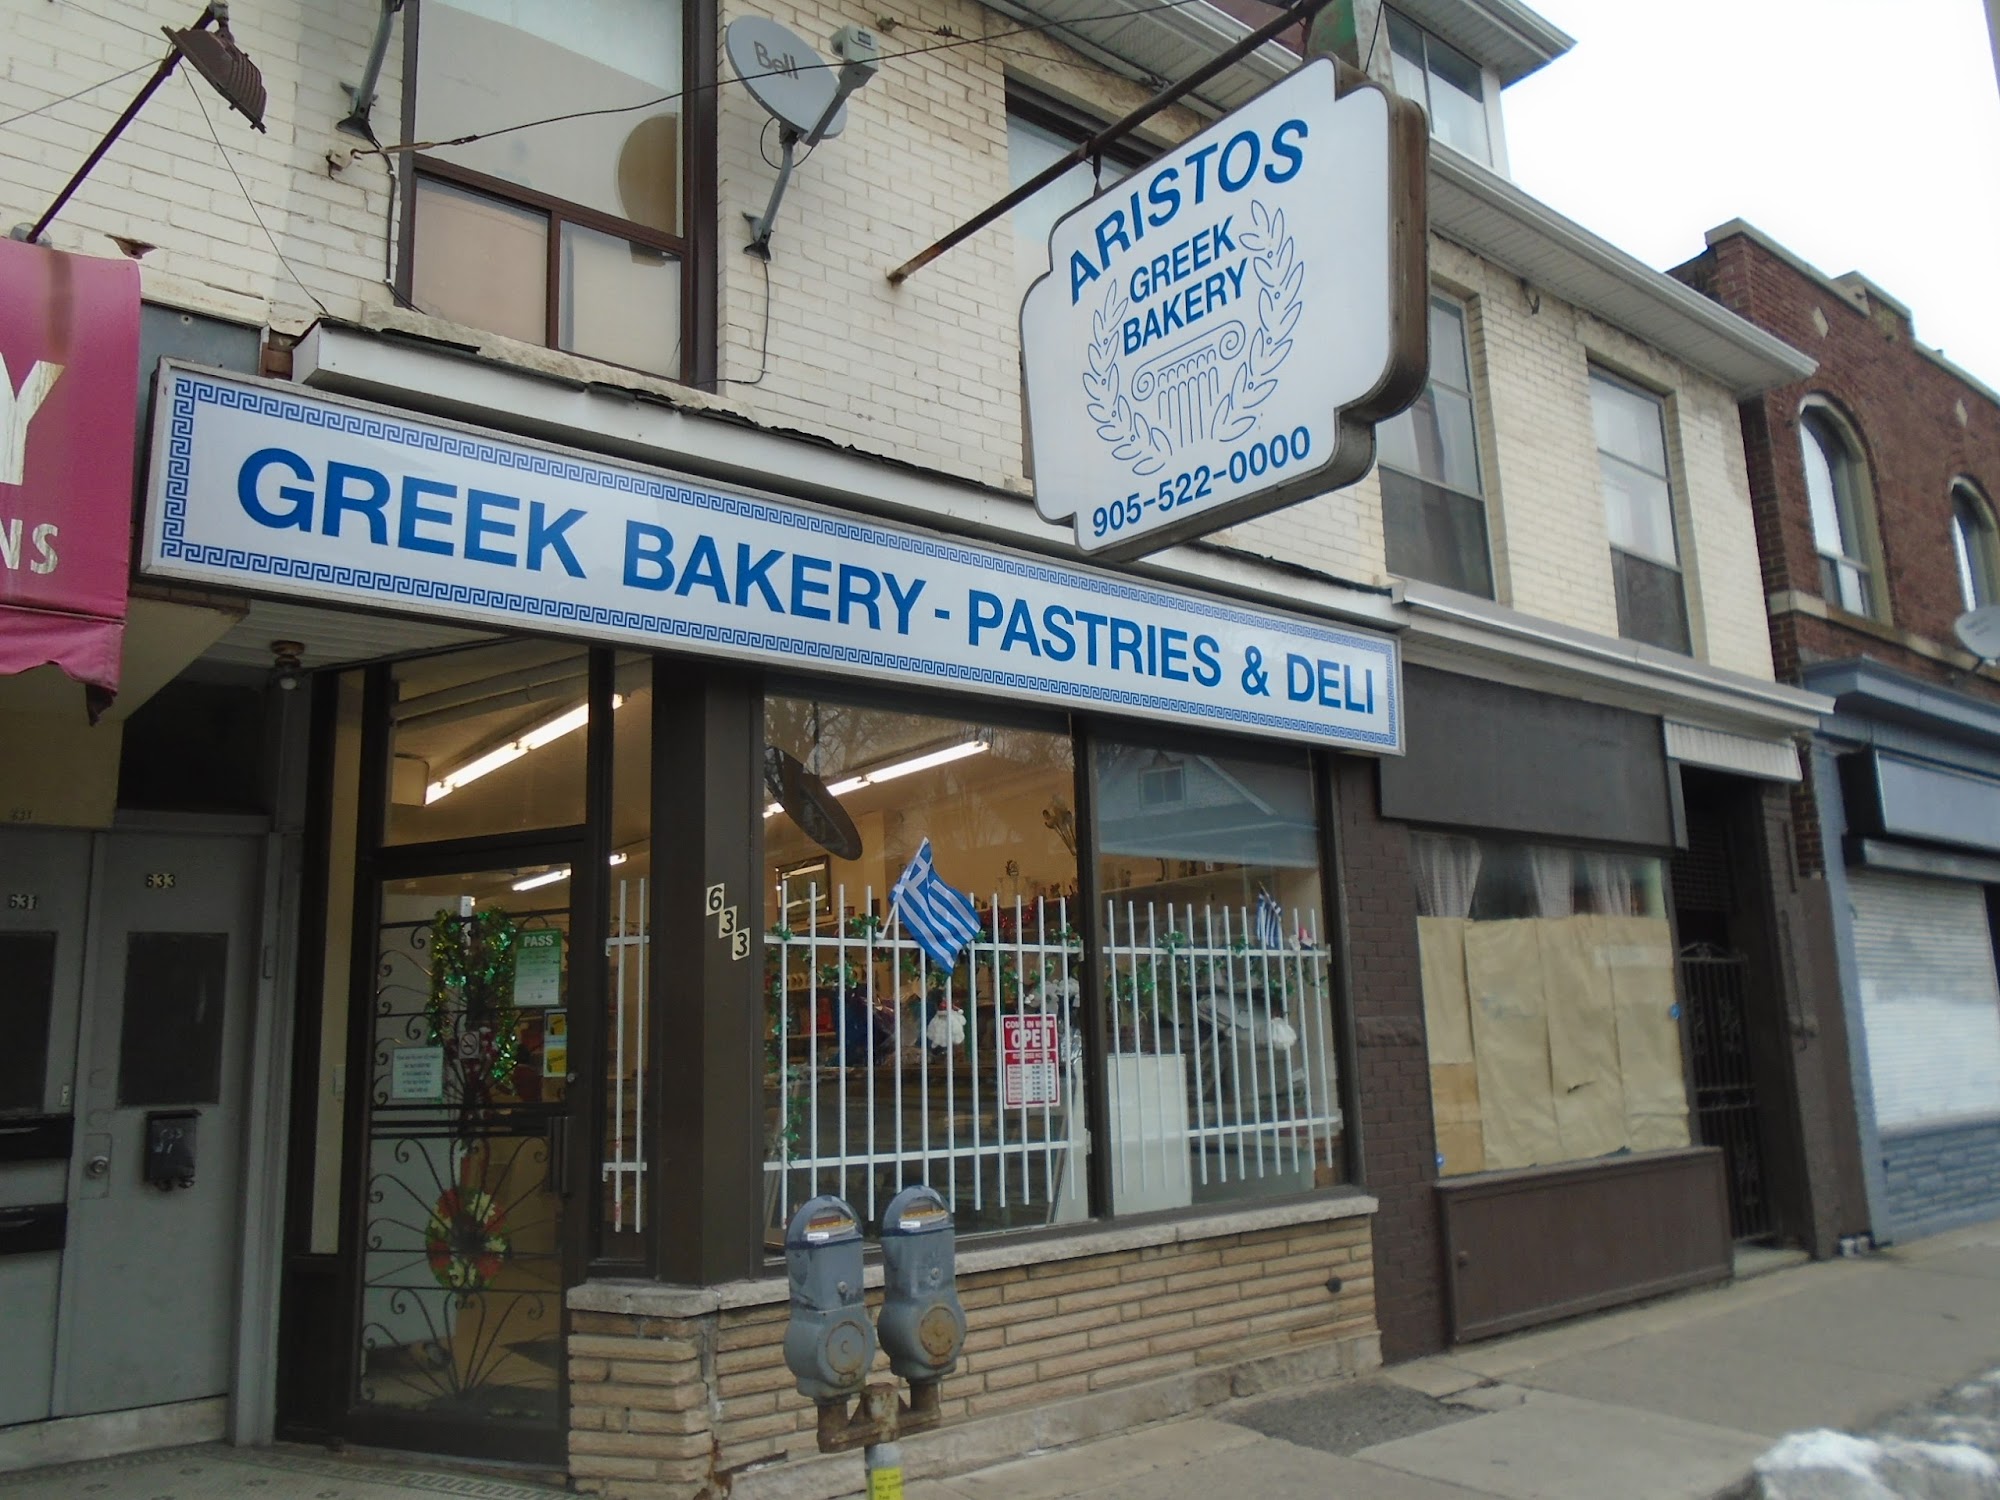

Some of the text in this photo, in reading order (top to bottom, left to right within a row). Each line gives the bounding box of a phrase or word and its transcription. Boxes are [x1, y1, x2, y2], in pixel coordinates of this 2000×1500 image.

[754, 41, 799, 80] Bell
[1071, 118, 1311, 304] ARISTOS
[1130, 216, 1237, 304] GREEK
[1123, 258, 1248, 356] BAKERY
[1092, 425, 1312, 538] 905-522-0000
[237, 447, 587, 580] GREEK
[622, 519, 927, 636] BAKERY
[967, 588, 1222, 689] PASTRIES
[1241, 645, 1272, 698] &
[1287, 652, 1376, 715] DELI
[8, 894, 38, 910] 631
[146, 873, 176, 889] 633
[523, 934, 554, 948] PASS
[708, 886, 748, 957] 633
